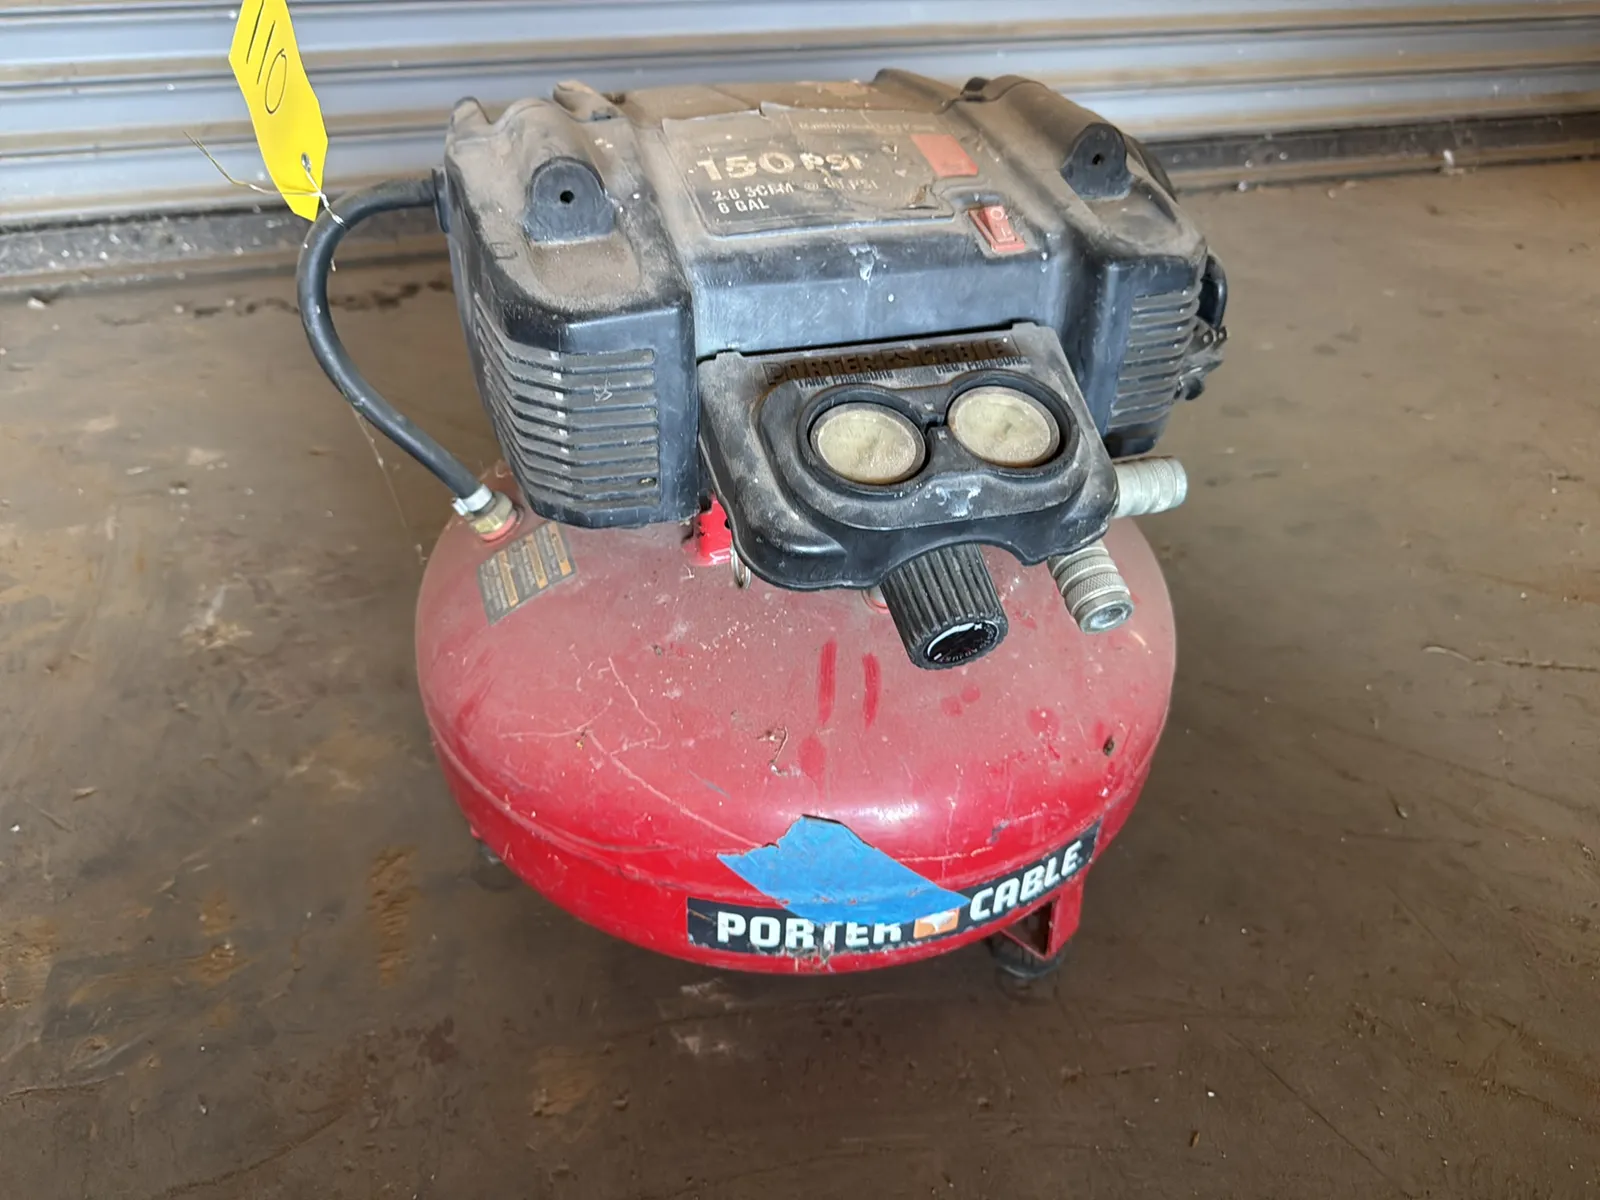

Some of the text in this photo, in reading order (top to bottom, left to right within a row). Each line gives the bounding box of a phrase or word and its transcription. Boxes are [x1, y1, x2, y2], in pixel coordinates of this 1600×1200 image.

[696, 152, 795, 181] 150
[736, 197, 770, 213] GAL
[798, 375, 828, 389] TANK
[968, 840, 1085, 921] CABLE
